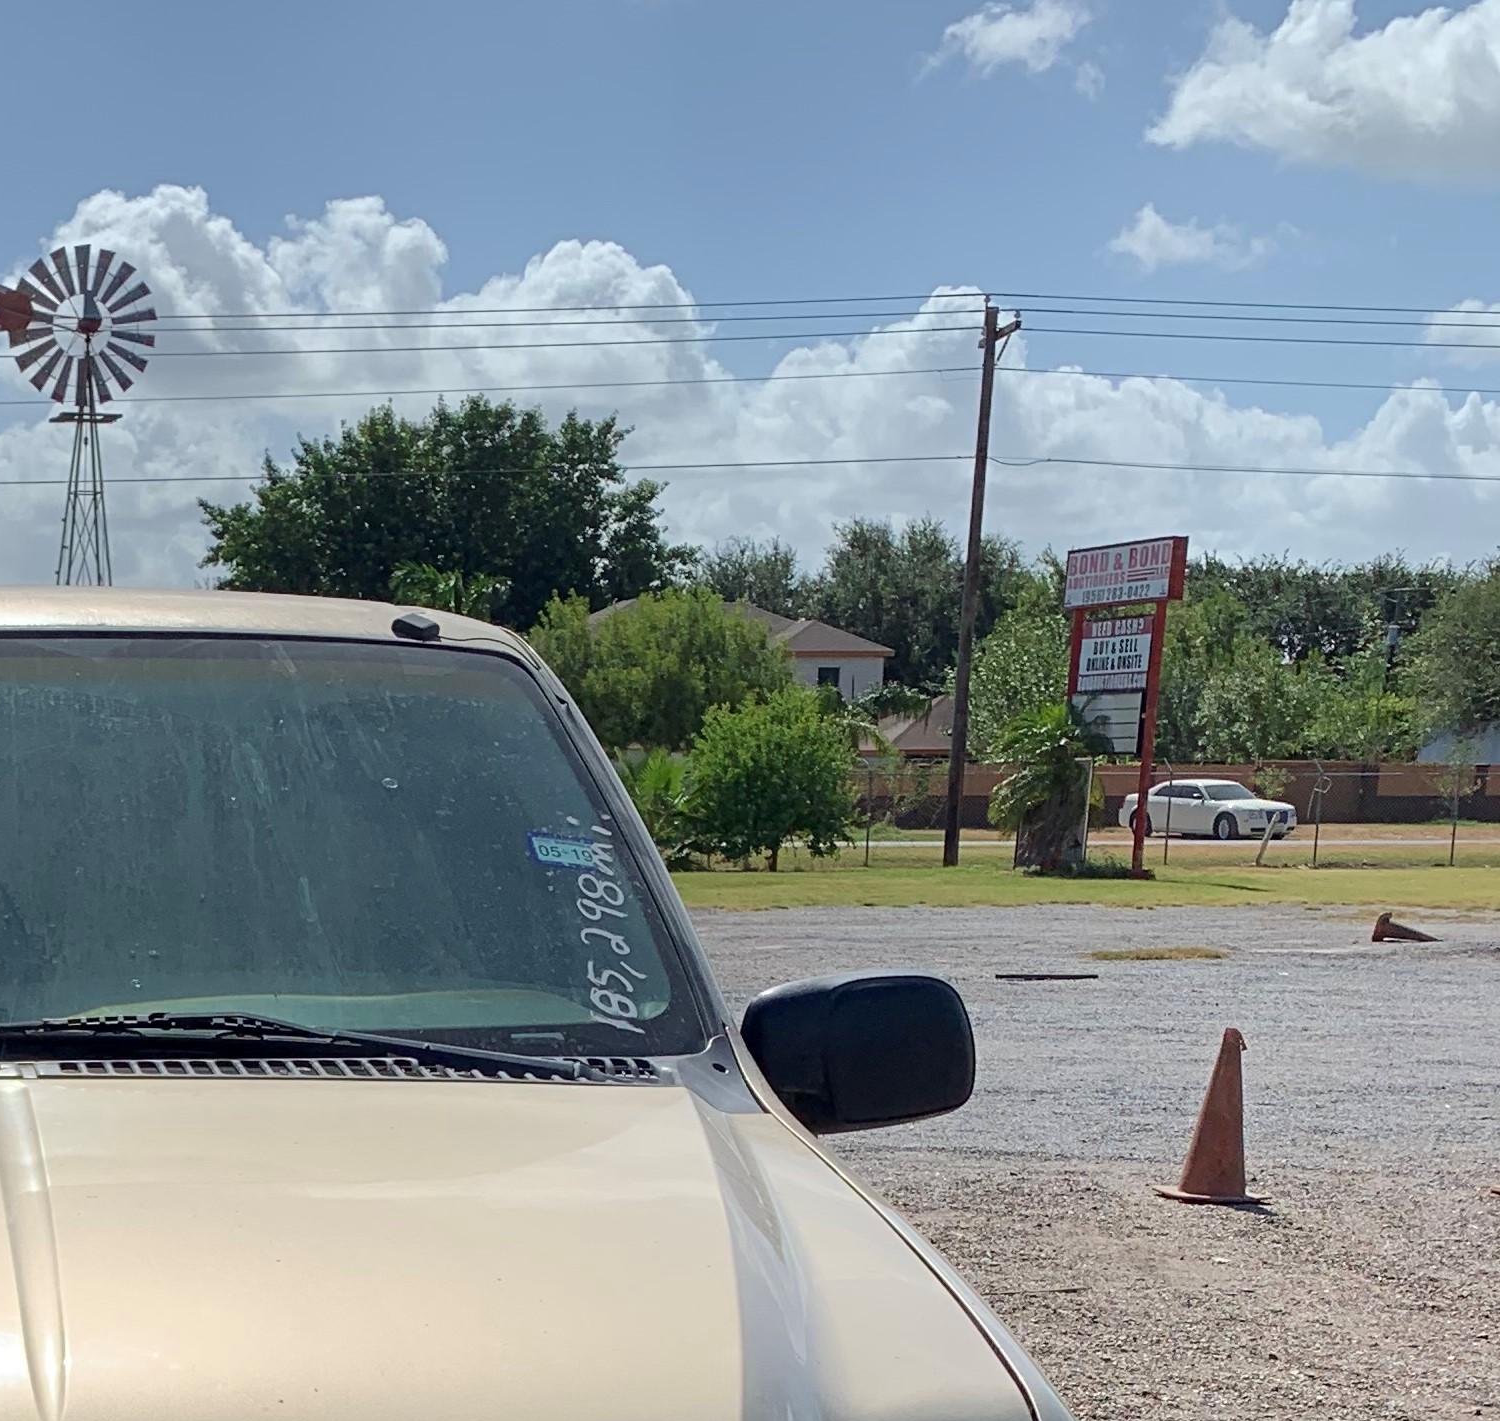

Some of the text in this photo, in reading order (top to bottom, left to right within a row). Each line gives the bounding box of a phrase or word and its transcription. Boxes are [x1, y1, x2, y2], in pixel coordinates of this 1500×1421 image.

[1069, 542, 1172, 576] BOND & BOND
[1092, 620, 1112, 637] NEED
[1093, 638, 1138, 655] BUY & SELL
[1086, 656, 1110, 672] ONLINE
[1117, 654, 1143, 670] ONSITE
